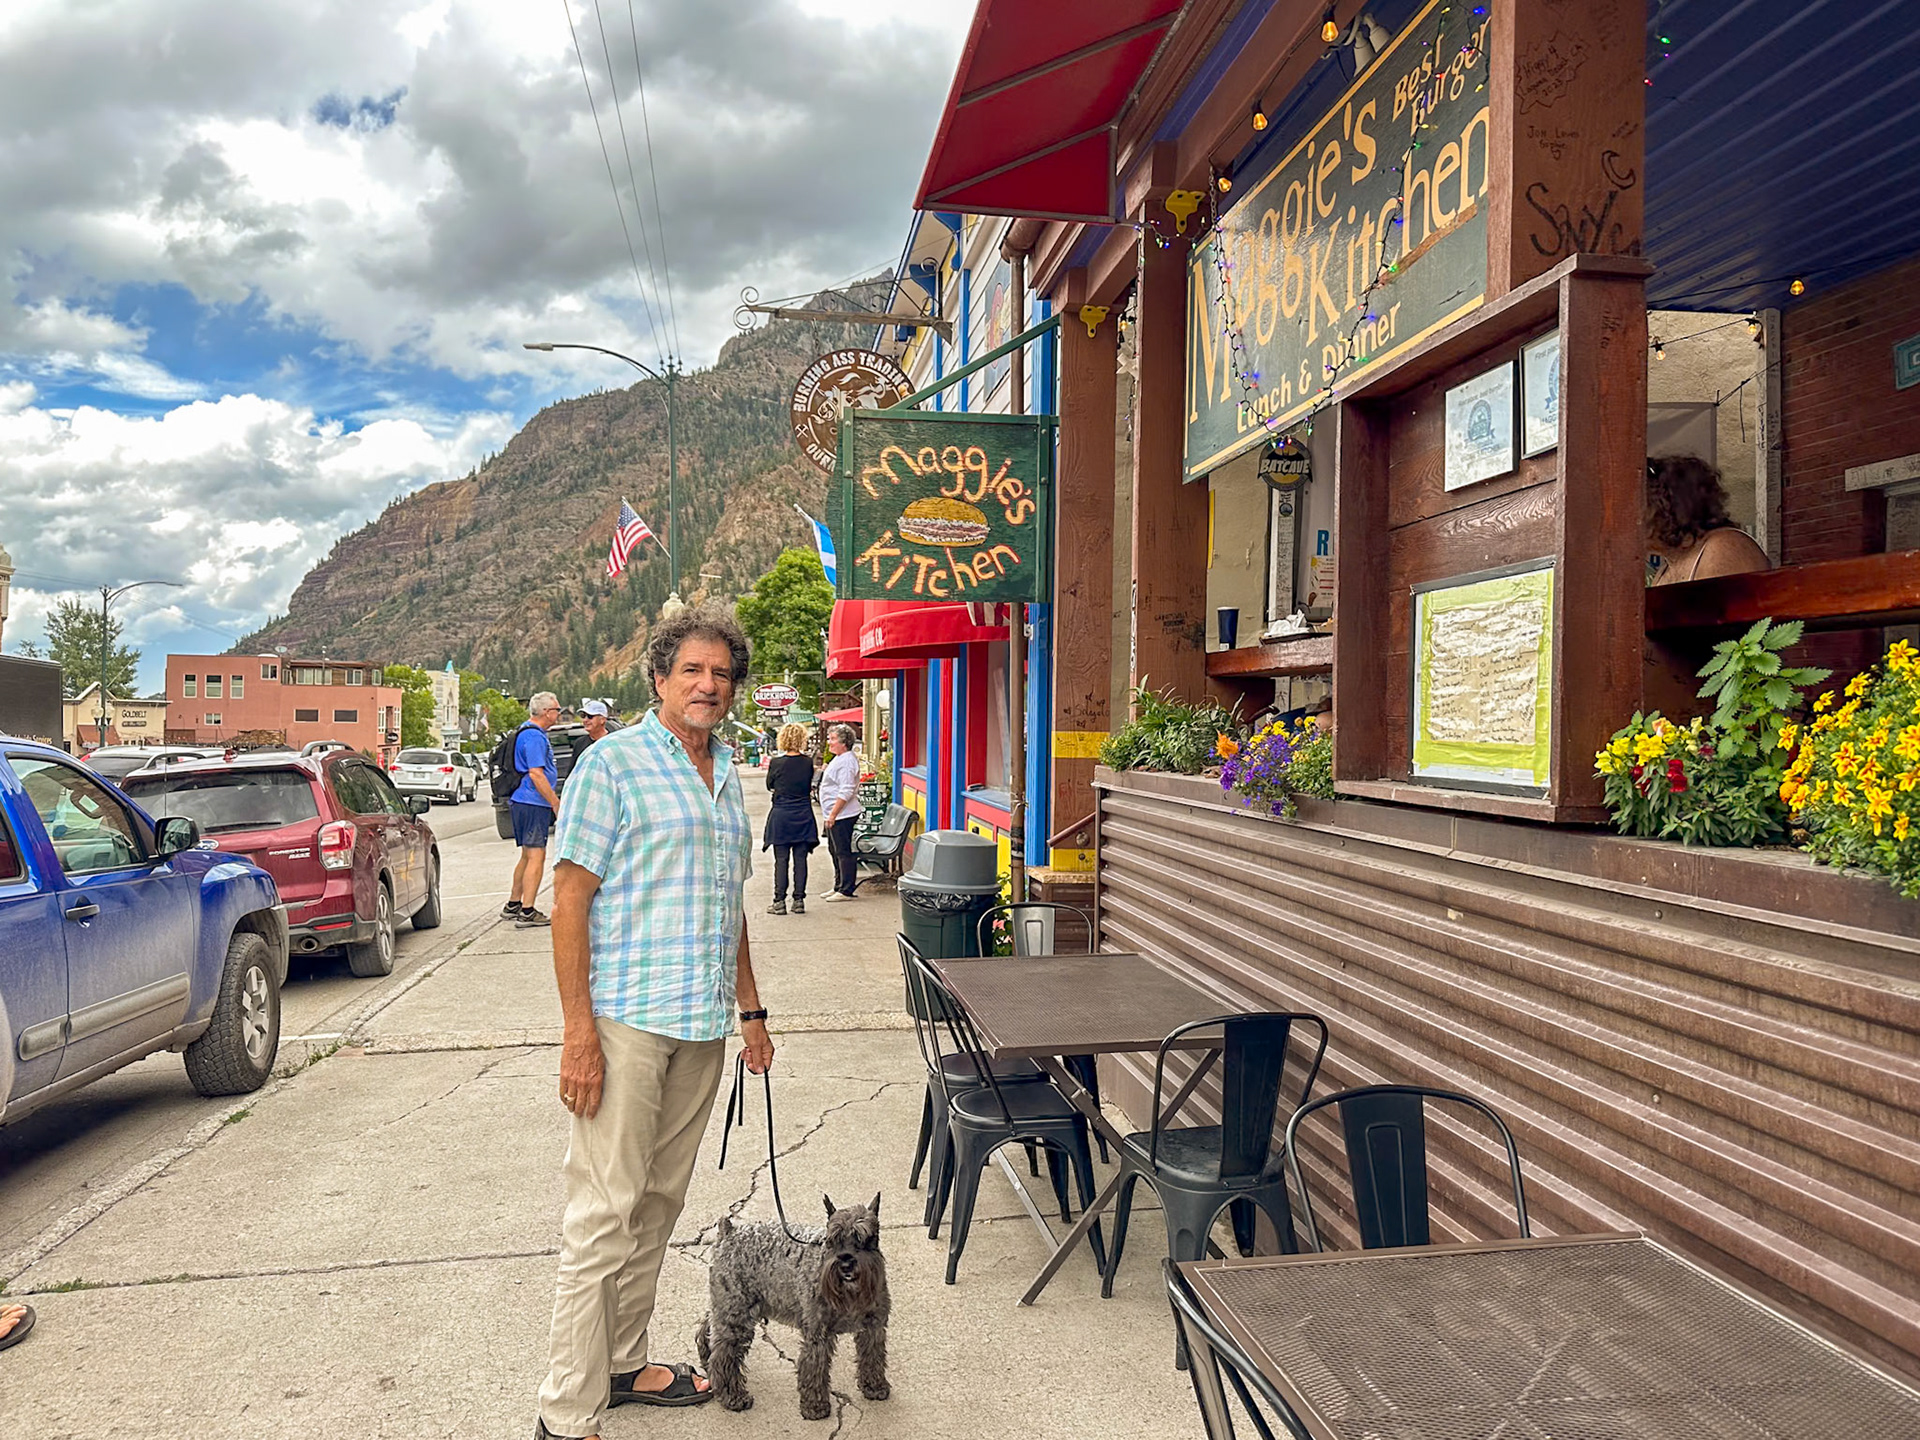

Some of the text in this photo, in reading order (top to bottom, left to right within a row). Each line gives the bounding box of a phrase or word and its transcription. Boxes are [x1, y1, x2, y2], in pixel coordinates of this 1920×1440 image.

[1392, 33, 1444, 122] Best
[1410, 15, 1491, 137] Burger
[1189, 98, 1377, 424] Maggie's
[1306, 106, 1490, 348] Kitchen
[793, 359, 832, 412] BURNING
[832, 351, 856, 368] ASS
[1237, 301, 1401, 434] Lunch & Dinner
[806, 443, 837, 472] OURA
[861, 445, 1036, 526] Maggie's
[1260, 458, 1311, 474] BATCAVE
[122, 709, 147, 718] GOLDBELT
[755, 691, 797, 701] BRICKHOUSE
[269, 848, 310, 856] FORESTER
